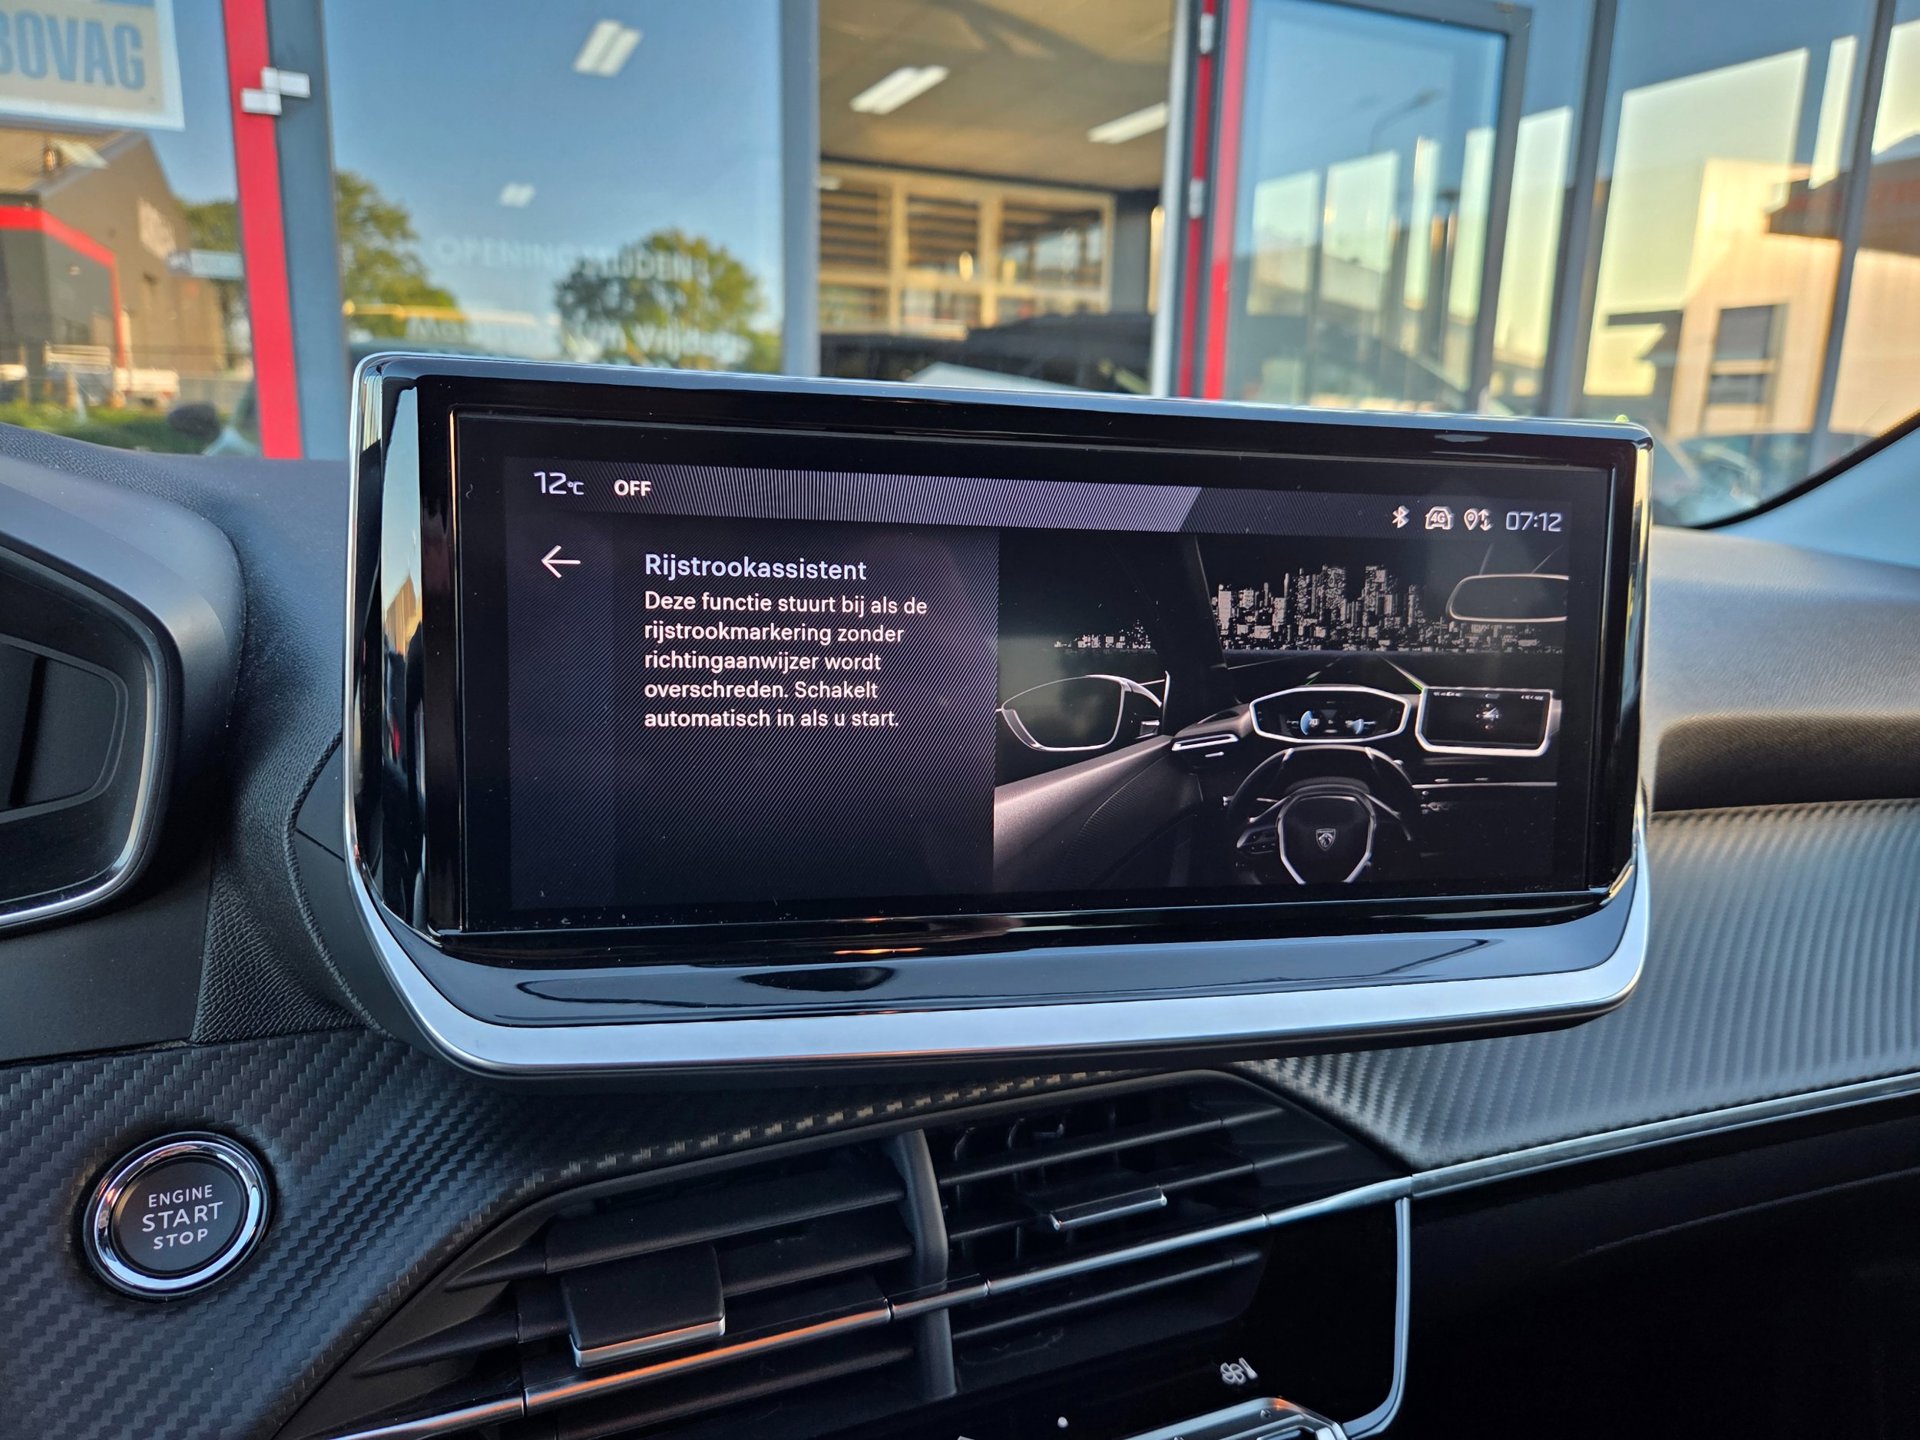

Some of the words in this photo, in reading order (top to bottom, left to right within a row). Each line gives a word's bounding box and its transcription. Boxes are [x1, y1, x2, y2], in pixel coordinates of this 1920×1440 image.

[614, 480, 652, 497] OFF
[1505, 510, 1563, 532] 07:12
[645, 554, 867, 581] Rijstrookassistent
[645, 592, 696, 611] Deze
[702, 592, 772, 612] functie
[778, 595, 836, 613] stuurt
[841, 597, 865, 617] bij
[870, 597, 898, 614] als
[903, 597, 928, 615] de
[645, 621, 832, 645] rijstrookmarkering
[837, 624, 904, 643] zonder
[645, 651, 819, 674] richtingaanwijzer
[824, 653, 881, 671] wordt
[645, 680, 788, 699] overschreden.
[795, 681, 878, 699] Schakelt
[645, 709, 770, 728] automatisch
[777, 710, 794, 727] in
[800, 710, 829, 727] als
[834, 713, 846, 727] u
[852, 711, 899, 728] start.
[149, 1184, 213, 1208] ENGINE
[142, 1201, 224, 1232] START
[153, 1228, 209, 1250] STOP
